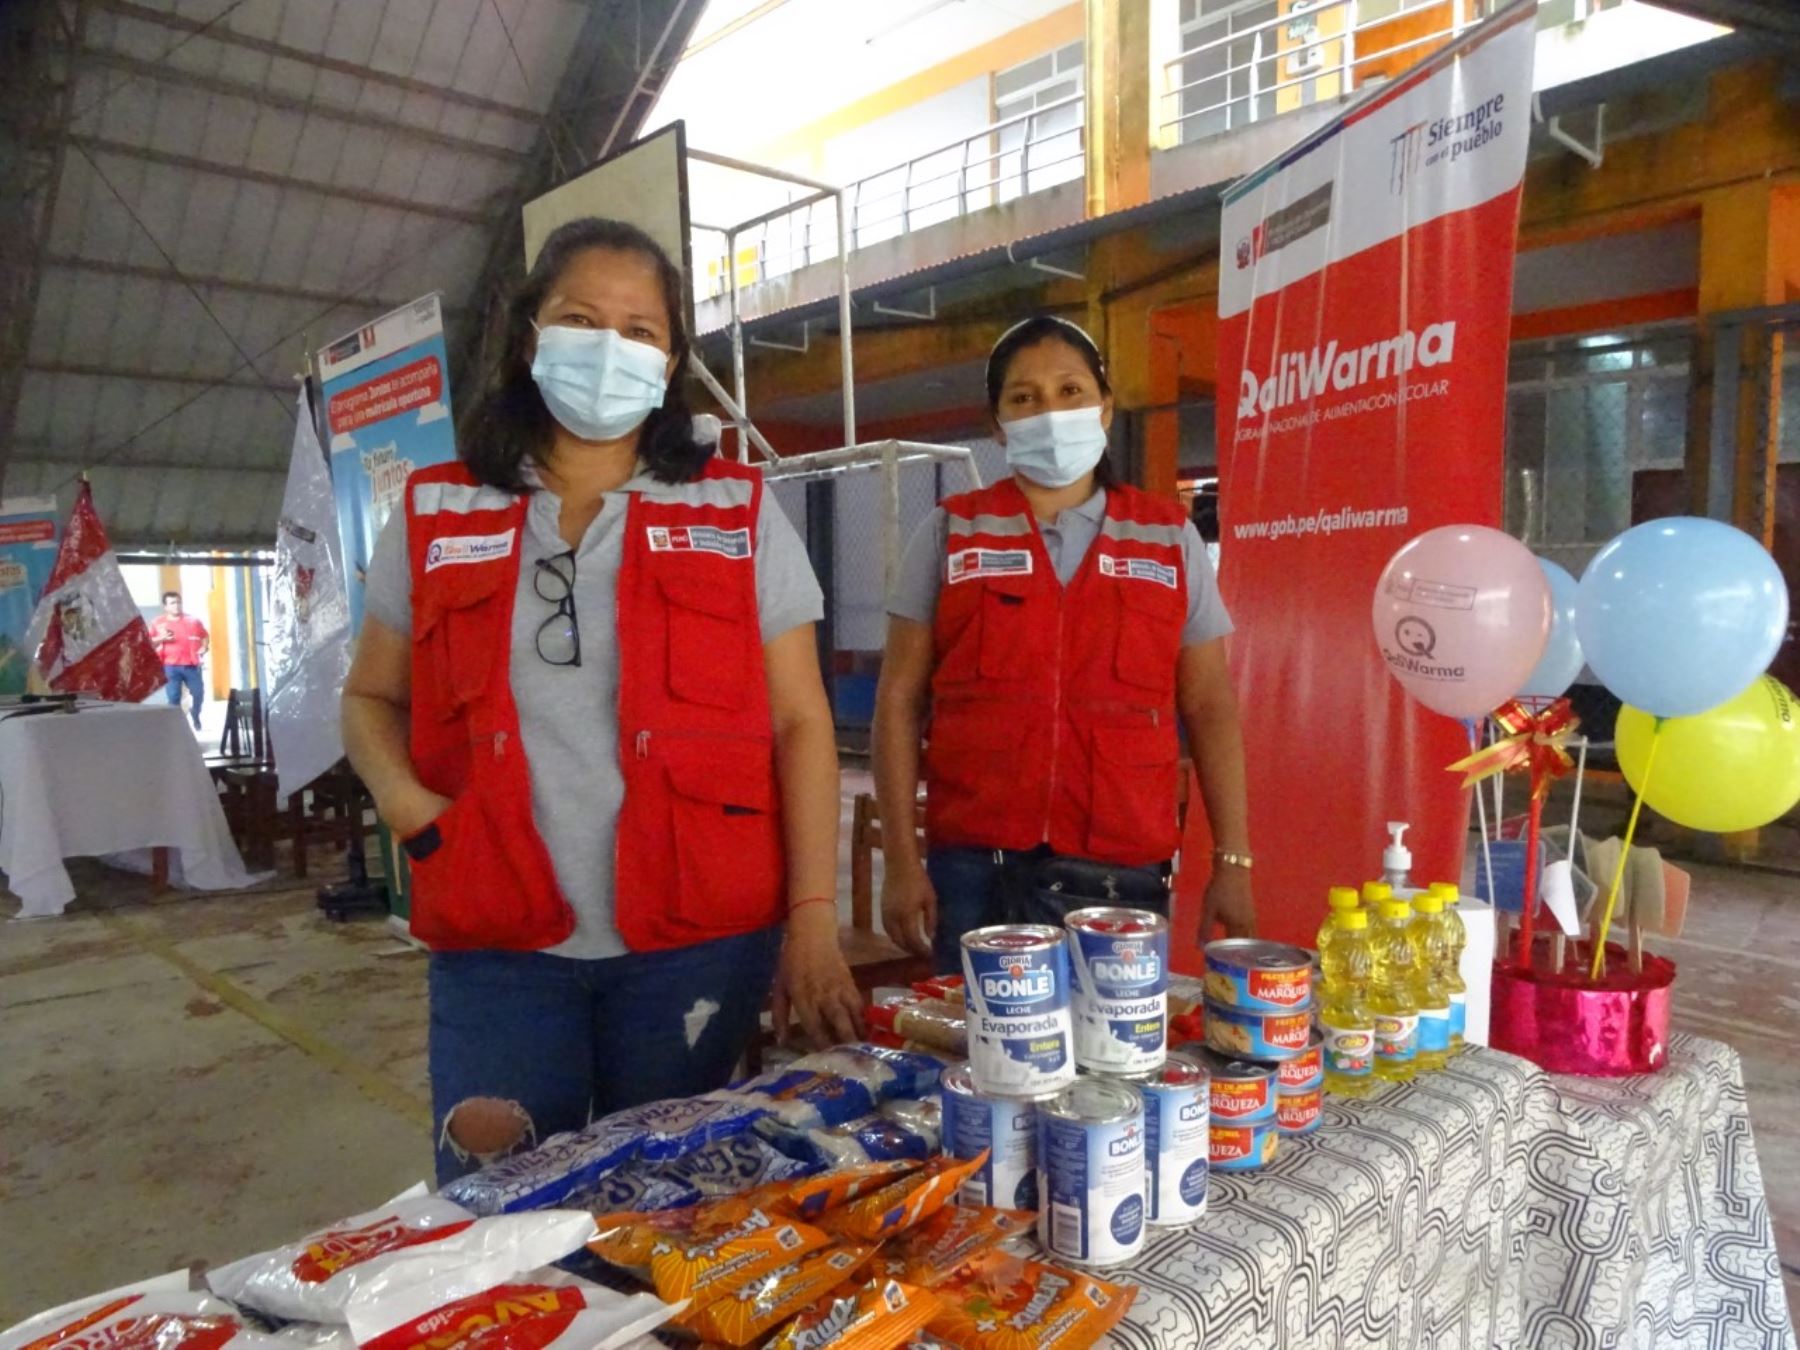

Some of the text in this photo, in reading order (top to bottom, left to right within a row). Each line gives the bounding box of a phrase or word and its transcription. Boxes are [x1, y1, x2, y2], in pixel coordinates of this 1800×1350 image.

[1428, 93, 1504, 147] Siempre
[1450, 120, 1502, 161] pueblo
[1234, 506, 1409, 541] www.gob.pe/qaliwarma
[983, 963, 1050, 998] BONLÉ
[981, 1015, 1058, 1037] Evaporada
